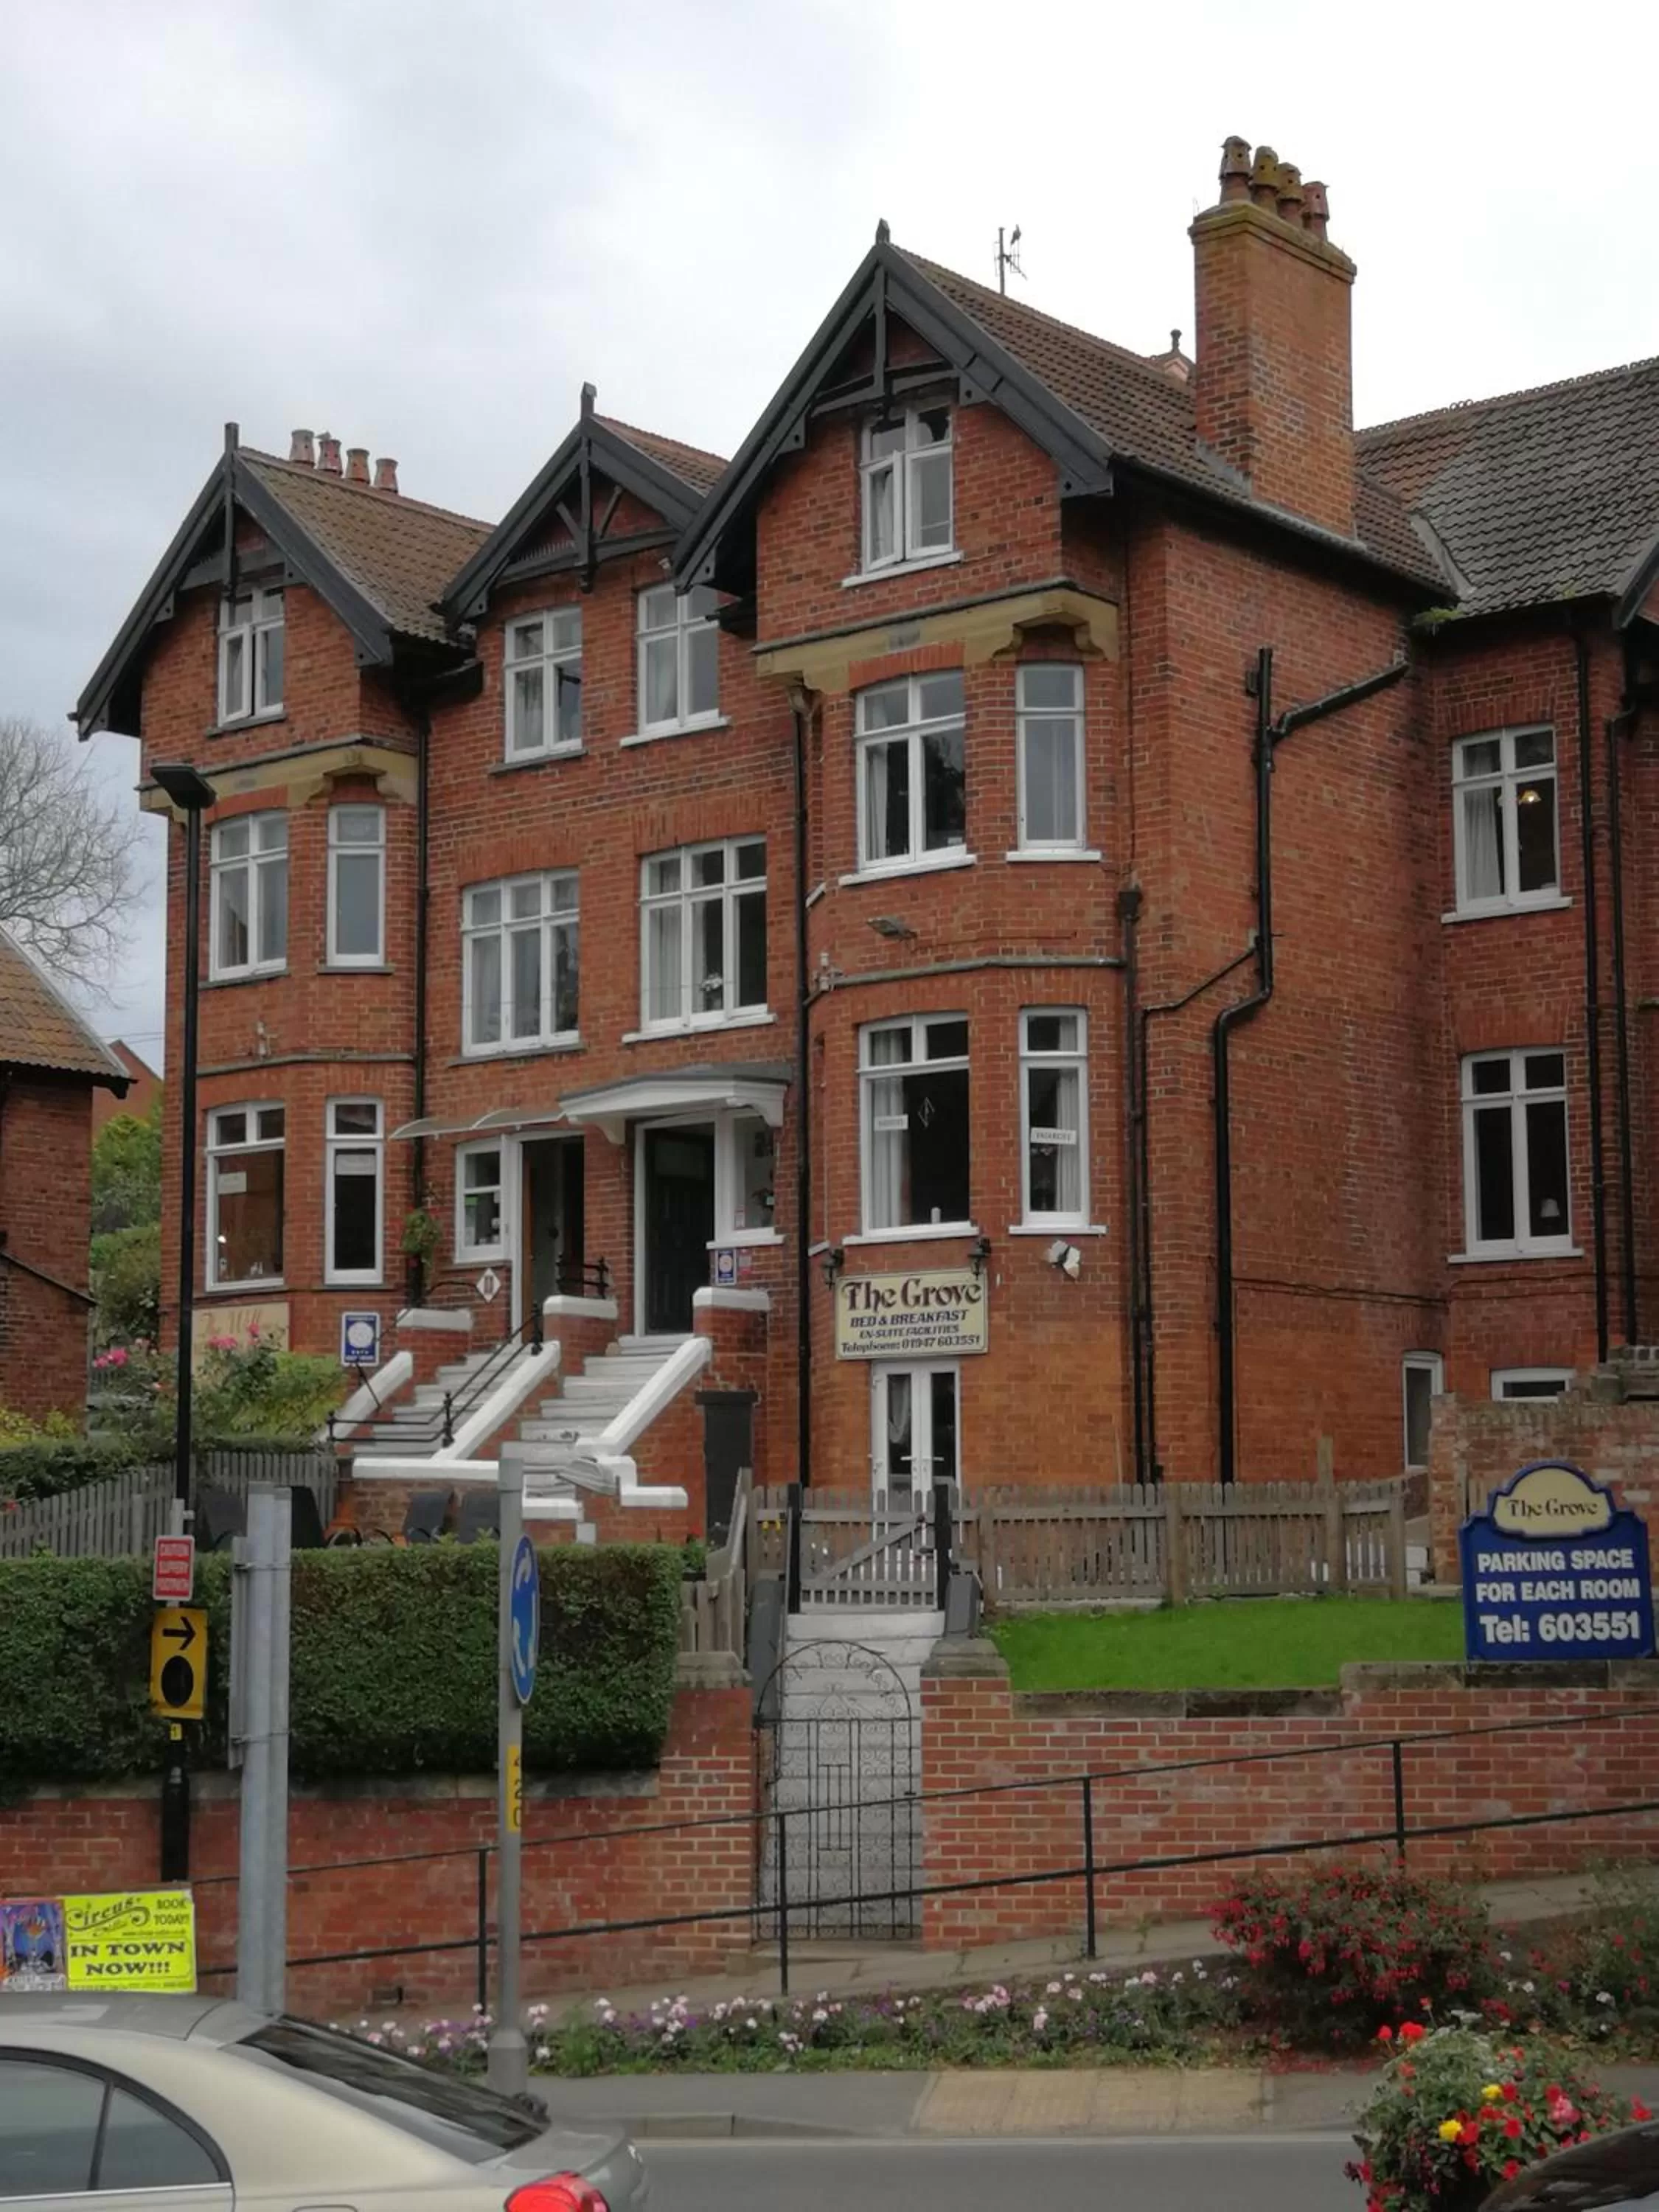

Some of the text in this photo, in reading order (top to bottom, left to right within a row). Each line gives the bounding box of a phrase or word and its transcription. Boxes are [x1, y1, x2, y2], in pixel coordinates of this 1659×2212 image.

[842, 1278, 981, 1312] The Grove
[850, 1310, 970, 1328] BED & BREAKFAST
[906, 1325, 960, 1337] FACILITIES
[901, 1337, 936, 1349] 01947
[937, 1335, 981, 1347] 603551
[1508, 1498, 1599, 1519] The Grove
[1477, 1548, 1635, 1573] PARKING SPACE
[1475, 1578, 1641, 1603] FOR EACH ROOM
[1479, 1611, 1641, 1644] Tel: 603551
[66, 1896, 148, 1931] Circus
[156, 1898, 187, 1910] BOOK
[71, 1941, 185, 1957] IN TOWN
[86, 1961, 170, 1976] NOW!!!
